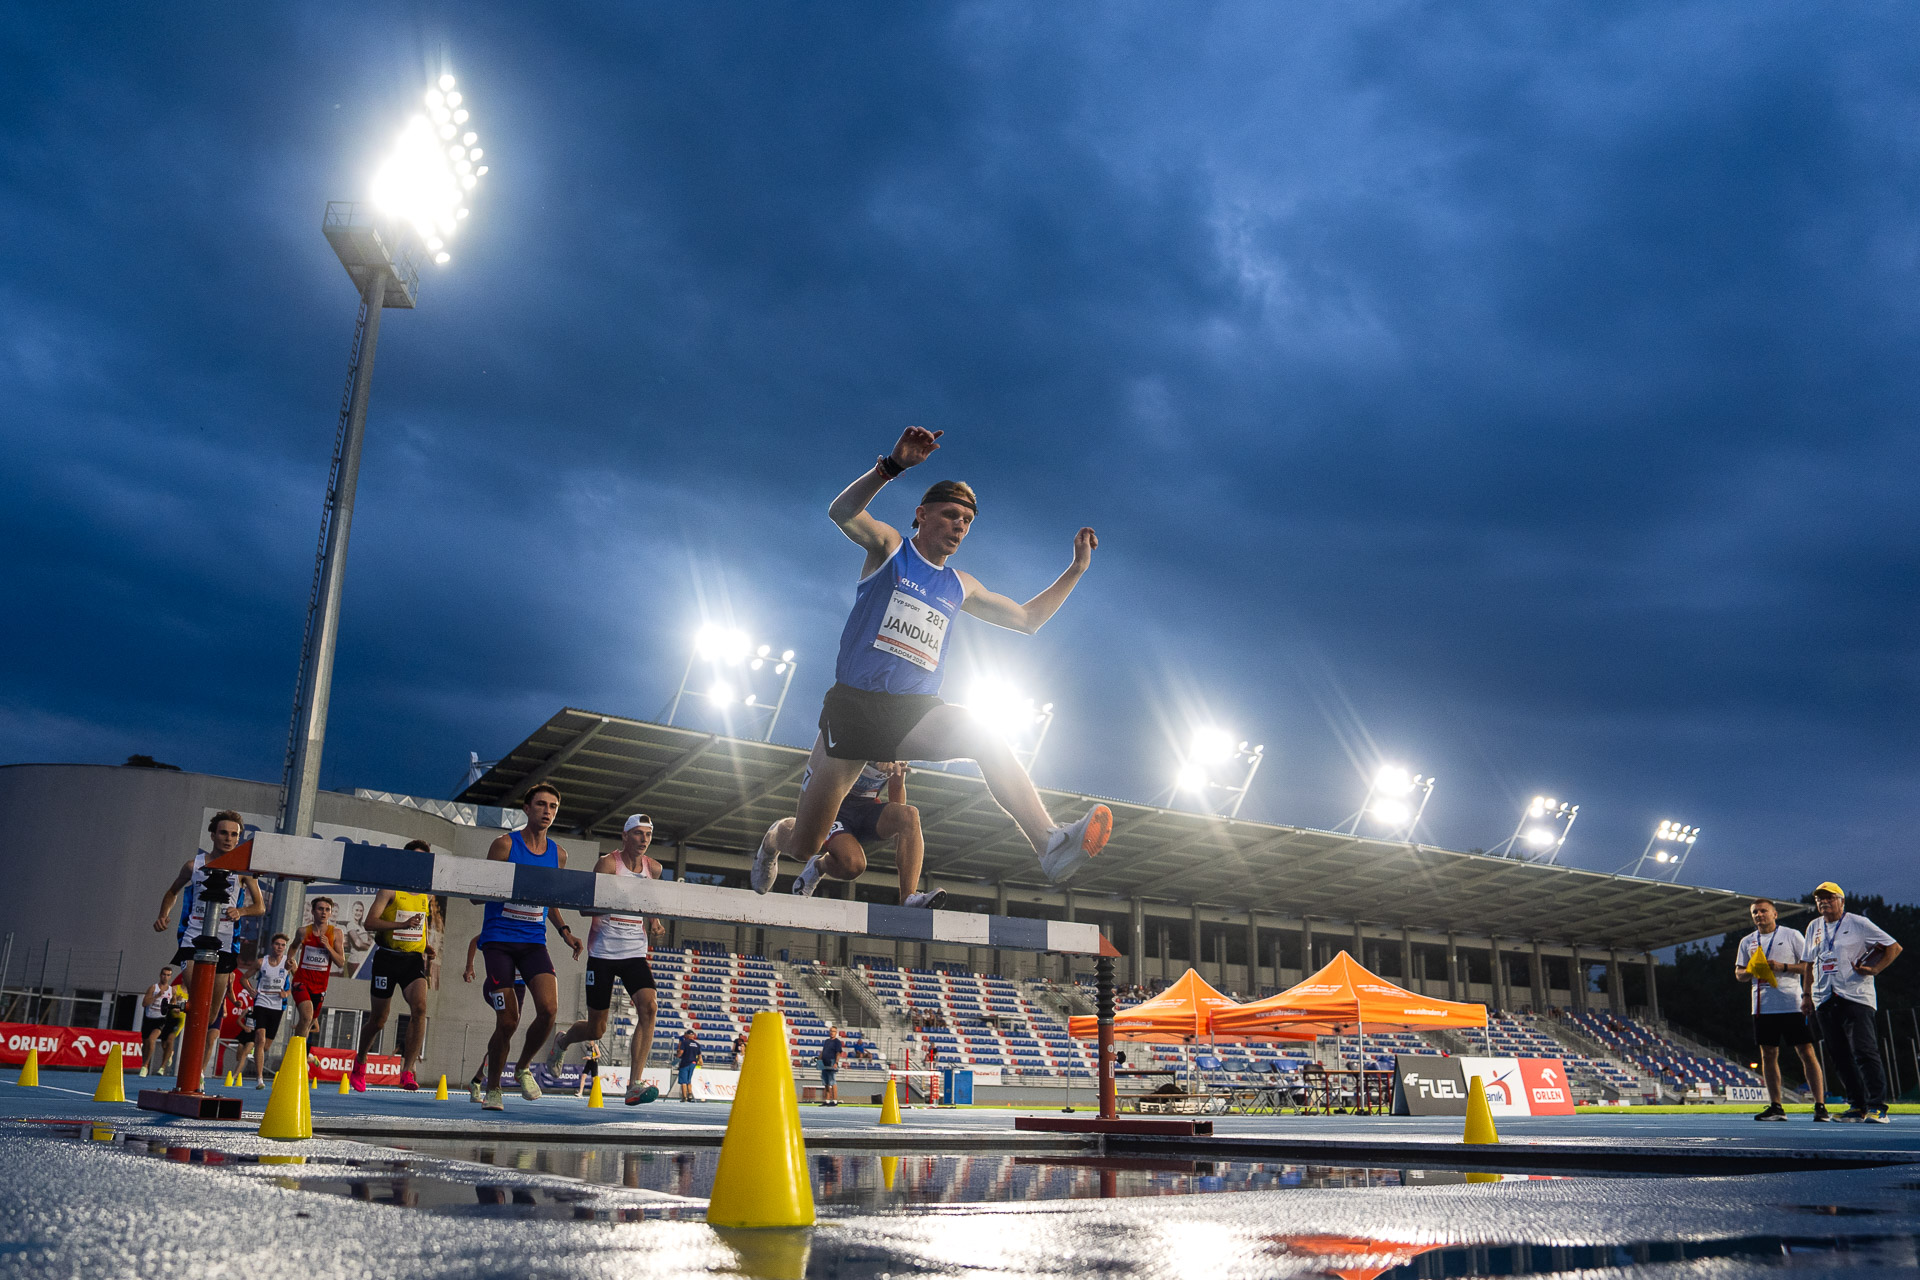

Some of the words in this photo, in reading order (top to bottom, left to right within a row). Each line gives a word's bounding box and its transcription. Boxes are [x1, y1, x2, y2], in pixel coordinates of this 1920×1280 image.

[905, 602, 920, 612] SPORT
[925, 610, 944, 631] 281
[884, 616, 939, 653] JANDUŁA
[889, 647, 912, 660] RADOM
[912, 655, 926, 666] 2024
[306, 955, 326, 963] KOBZA
[376, 977, 387, 988] 16
[496, 995, 505, 1007] 8
[8, 1034, 59, 1052] ORLEN
[320, 1057, 354, 1071] ORLE
[366, 1063, 401, 1075] RLEN
[1403, 1073, 1419, 1086] 4F
[1418, 1079, 1466, 1099] FUEL
[1732, 1088, 1765, 1100] RADOM
[1534, 1091, 1562, 1102] ORLEN
